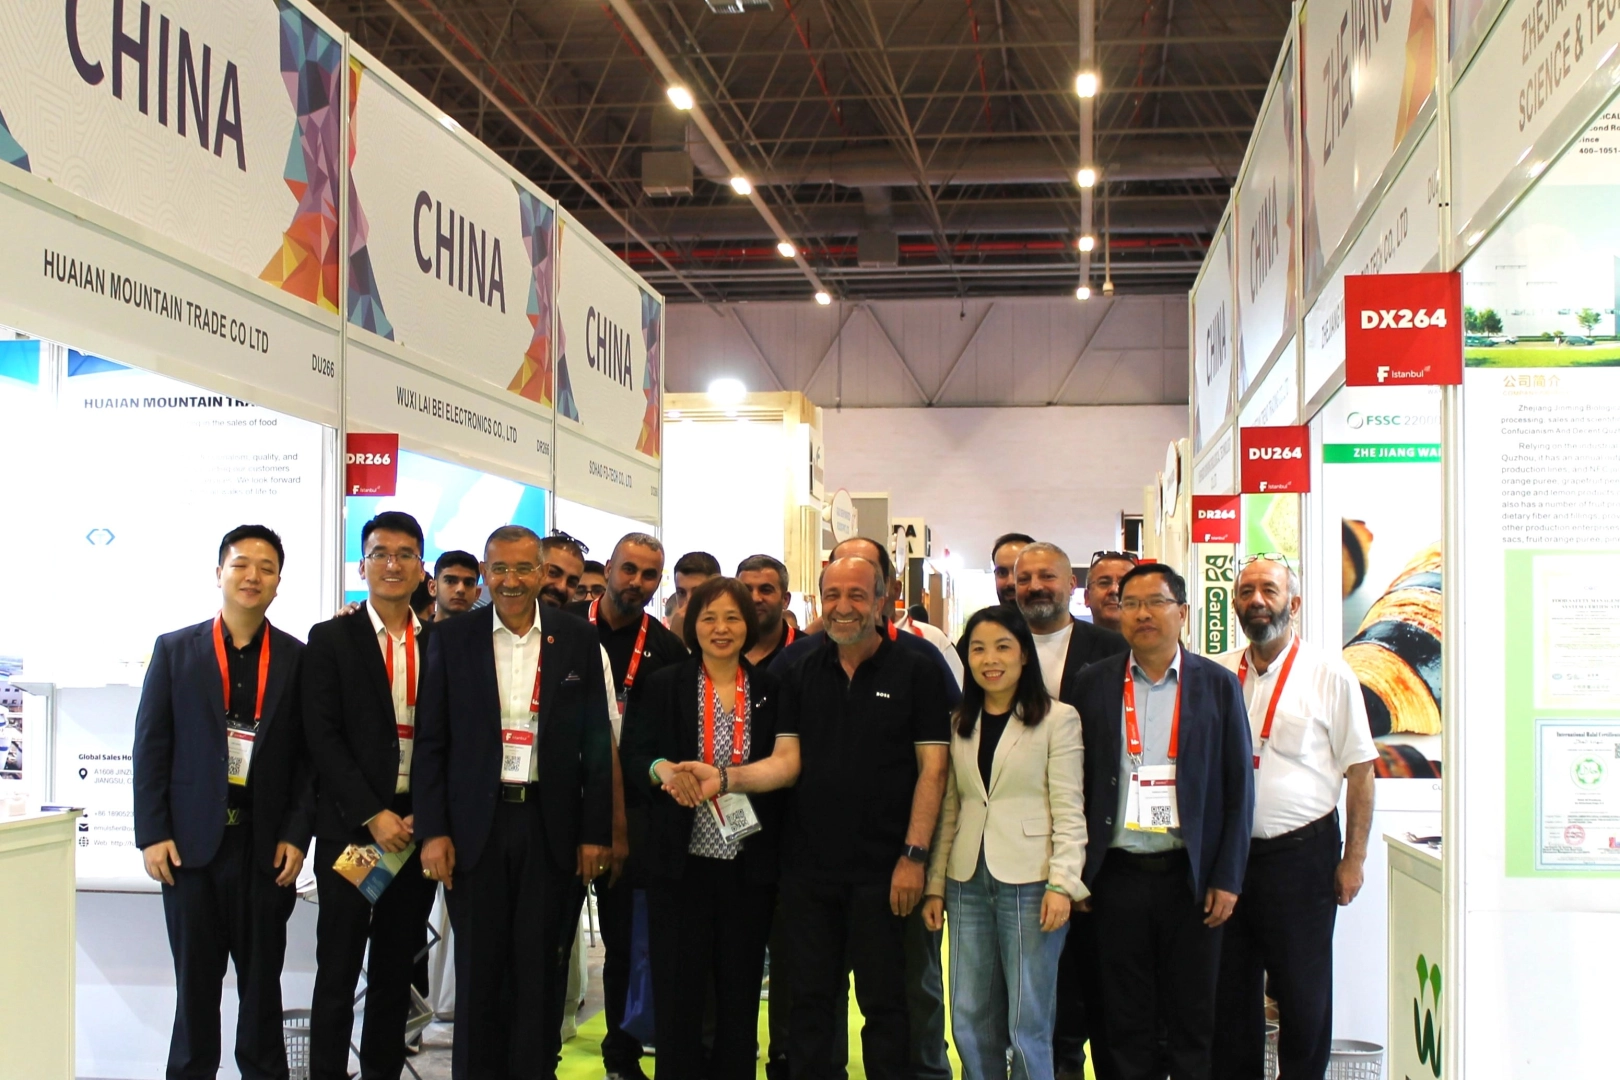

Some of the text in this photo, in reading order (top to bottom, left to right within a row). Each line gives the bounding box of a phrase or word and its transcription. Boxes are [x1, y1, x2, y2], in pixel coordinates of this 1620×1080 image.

[1519, 27, 1571, 132] SCIENCE
[1575, 13, 1584, 63] &
[65, 0, 247, 172] CHINA
[1250, 175, 1279, 304] CHINA
[413, 190, 506, 314] CHINA
[44, 248, 335, 379] HUAIAN MOUNTAIN TRADE CO LTD DU266
[1360, 308, 1447, 329] DX264
[585, 305, 633, 391] CHINA
[1206, 299, 1226, 387] CHINA
[1391, 370, 1424, 378] Istanbul
[1503, 375, 1561, 387] 公司简介
[84, 398, 140, 409] HUAIAN
[143, 396, 223, 408] MOUNTAIN
[1518, 404, 1552, 412] Zhejiang
[396, 386, 416, 410] WUXI
[419, 393, 430, 414] LAI
[432, 398, 444, 419] BEI
[446, 403, 492, 435] ELECTRONICS
[506, 424, 518, 443] LTD
[1548, 415, 1569, 423] sales
[1570, 414, 1584, 423] and
[249, 418, 257, 426] of
[259, 418, 278, 426] food
[1366, 416, 1401, 426] FSSC
[1501, 426, 1554, 435] Confucianism
[1518, 442, 1550, 452] Relying
[253, 453, 280, 461] quality,
[1249, 446, 1303, 460] DU264
[1353, 448, 1376, 458] ZHE
[1379, 447, 1415, 458] JIANG
[346, 453, 391, 465] DR266
[1501, 465, 1546, 474] production
[270, 475, 301, 483] forward
[1501, 478, 1531, 487] orange
[1501, 490, 1531, 498] orange
[1533, 488, 1548, 497] and
[1501, 500, 1519, 508] also
[1521, 499, 1536, 508] has
[1198, 509, 1236, 519] DR264
[1501, 511, 1531, 521] dietary
[1532, 511, 1551, 520] fiber
[1552, 511, 1568, 520] and
[1501, 523, 1523, 531] other
[1525, 523, 1569, 533] production
[1526, 535, 1543, 543] fruit
[1209, 588, 1225, 653] Garden
